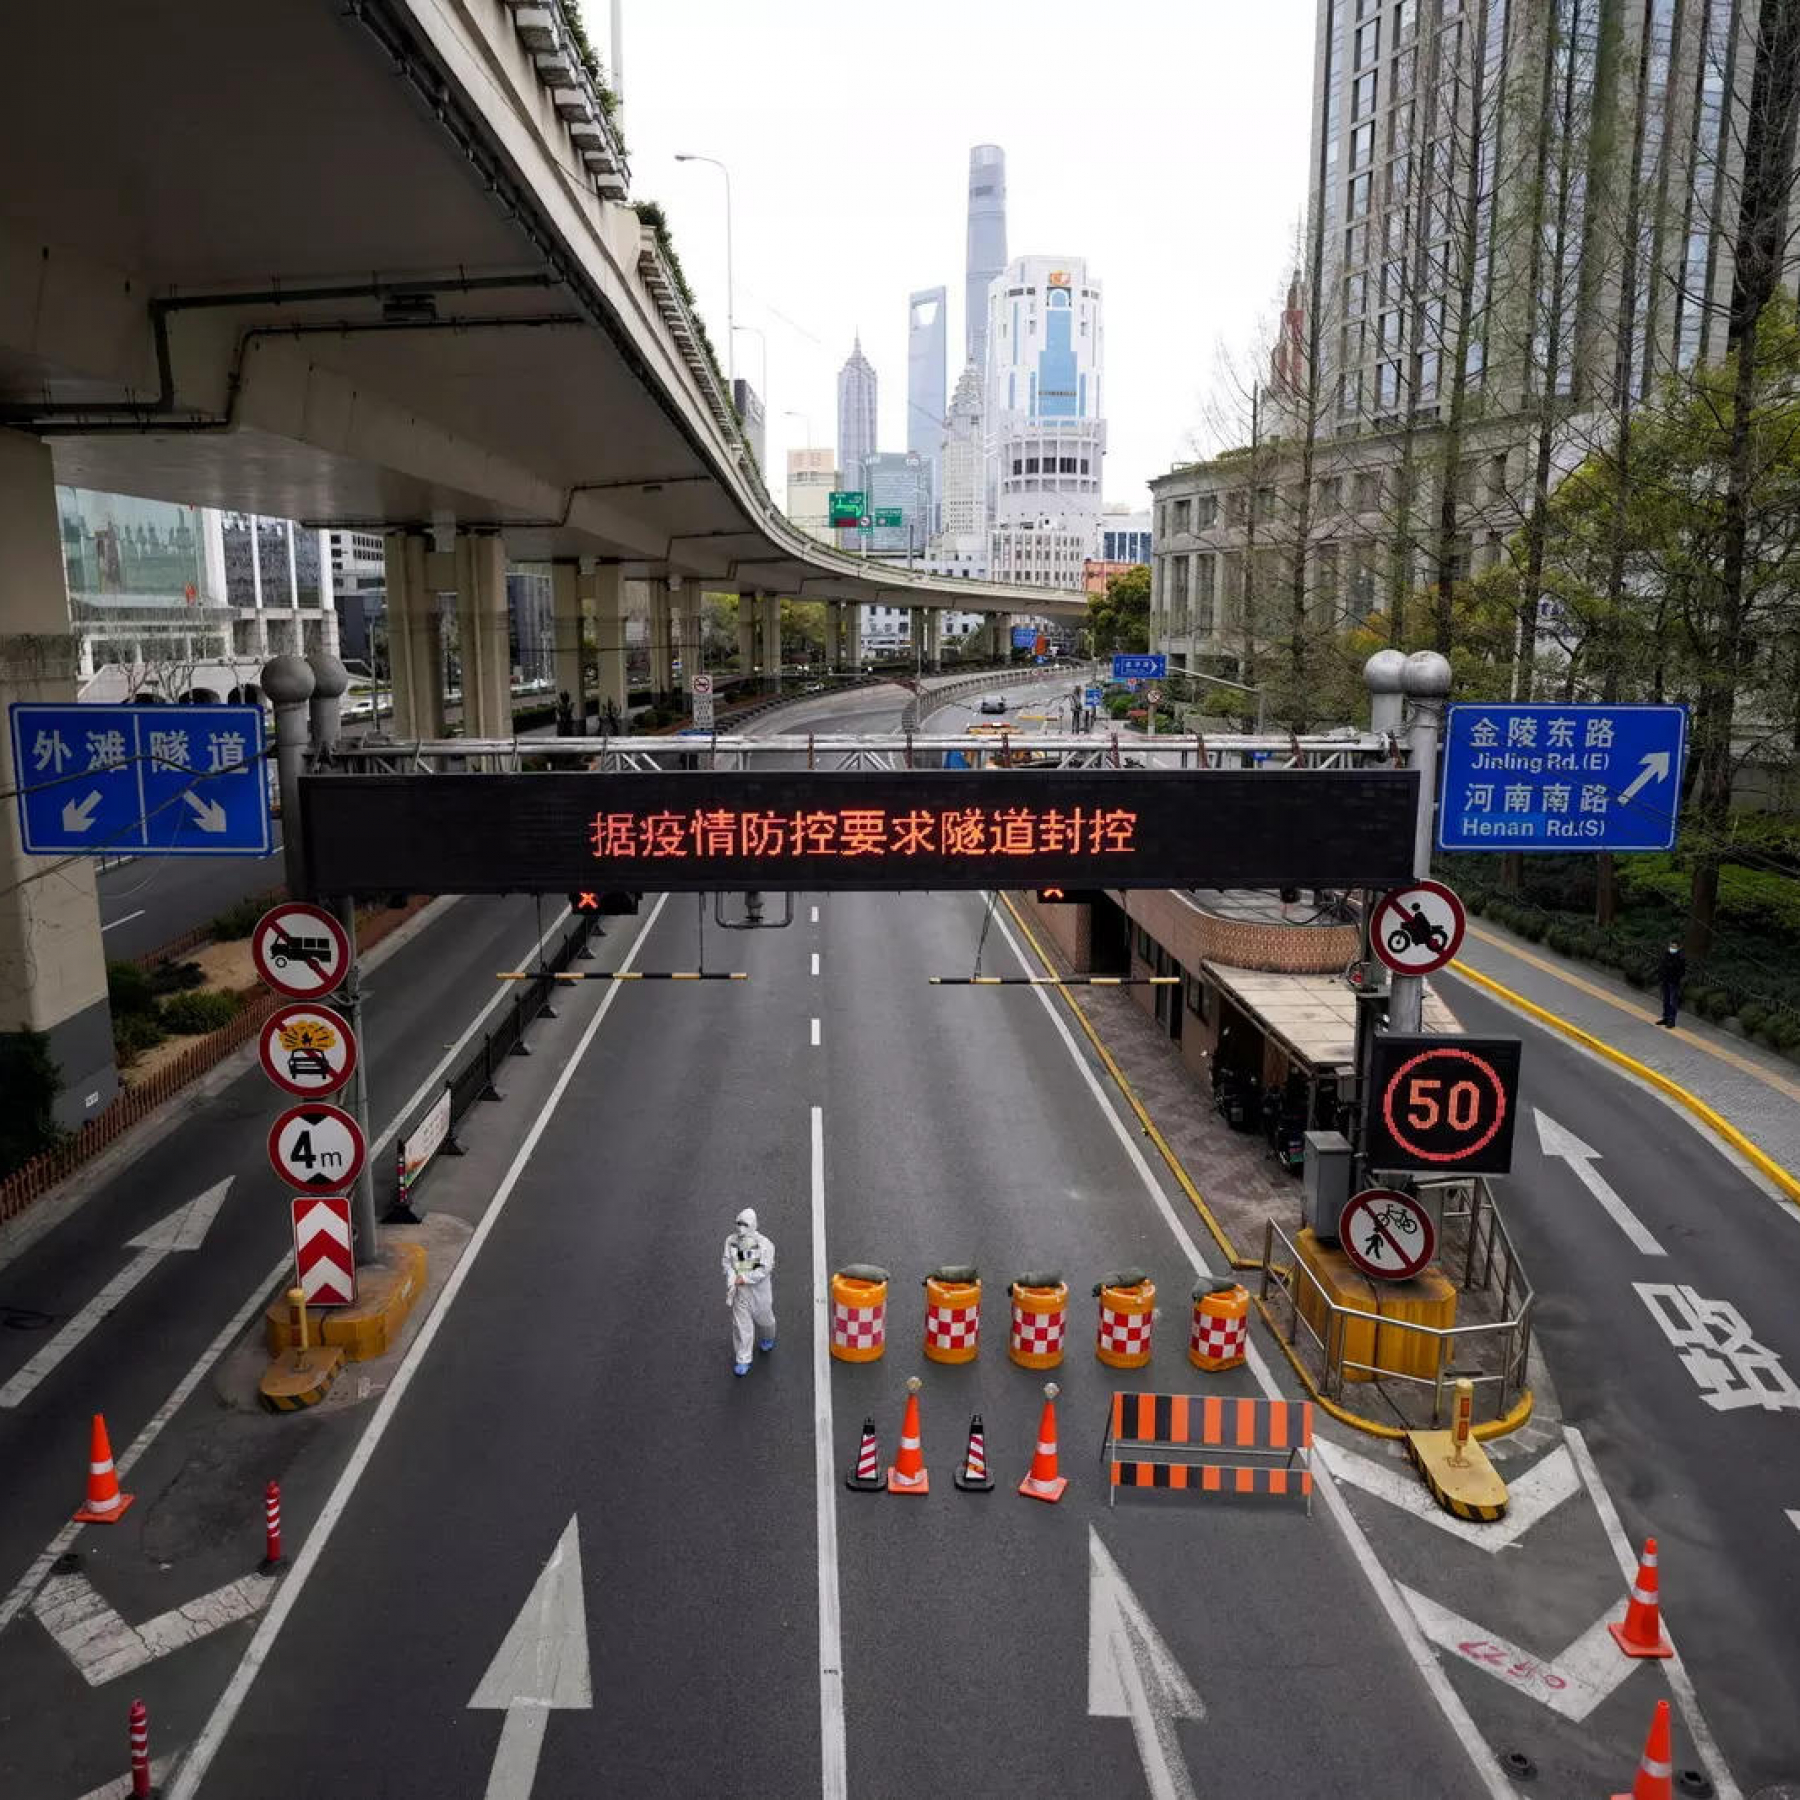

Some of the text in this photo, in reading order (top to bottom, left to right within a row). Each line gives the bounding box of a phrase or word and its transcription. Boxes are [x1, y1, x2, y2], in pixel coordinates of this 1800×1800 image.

[1470, 716, 1615, 748] 金陵东路
[1471, 752, 1543, 774] Jinling
[1464, 783, 1609, 813] 河南南路
[588, 807, 1138, 857] 据疫情防控要求隧道封控
[1462, 818, 1534, 836] Henan
[1407, 1079, 1480, 1131] 50
